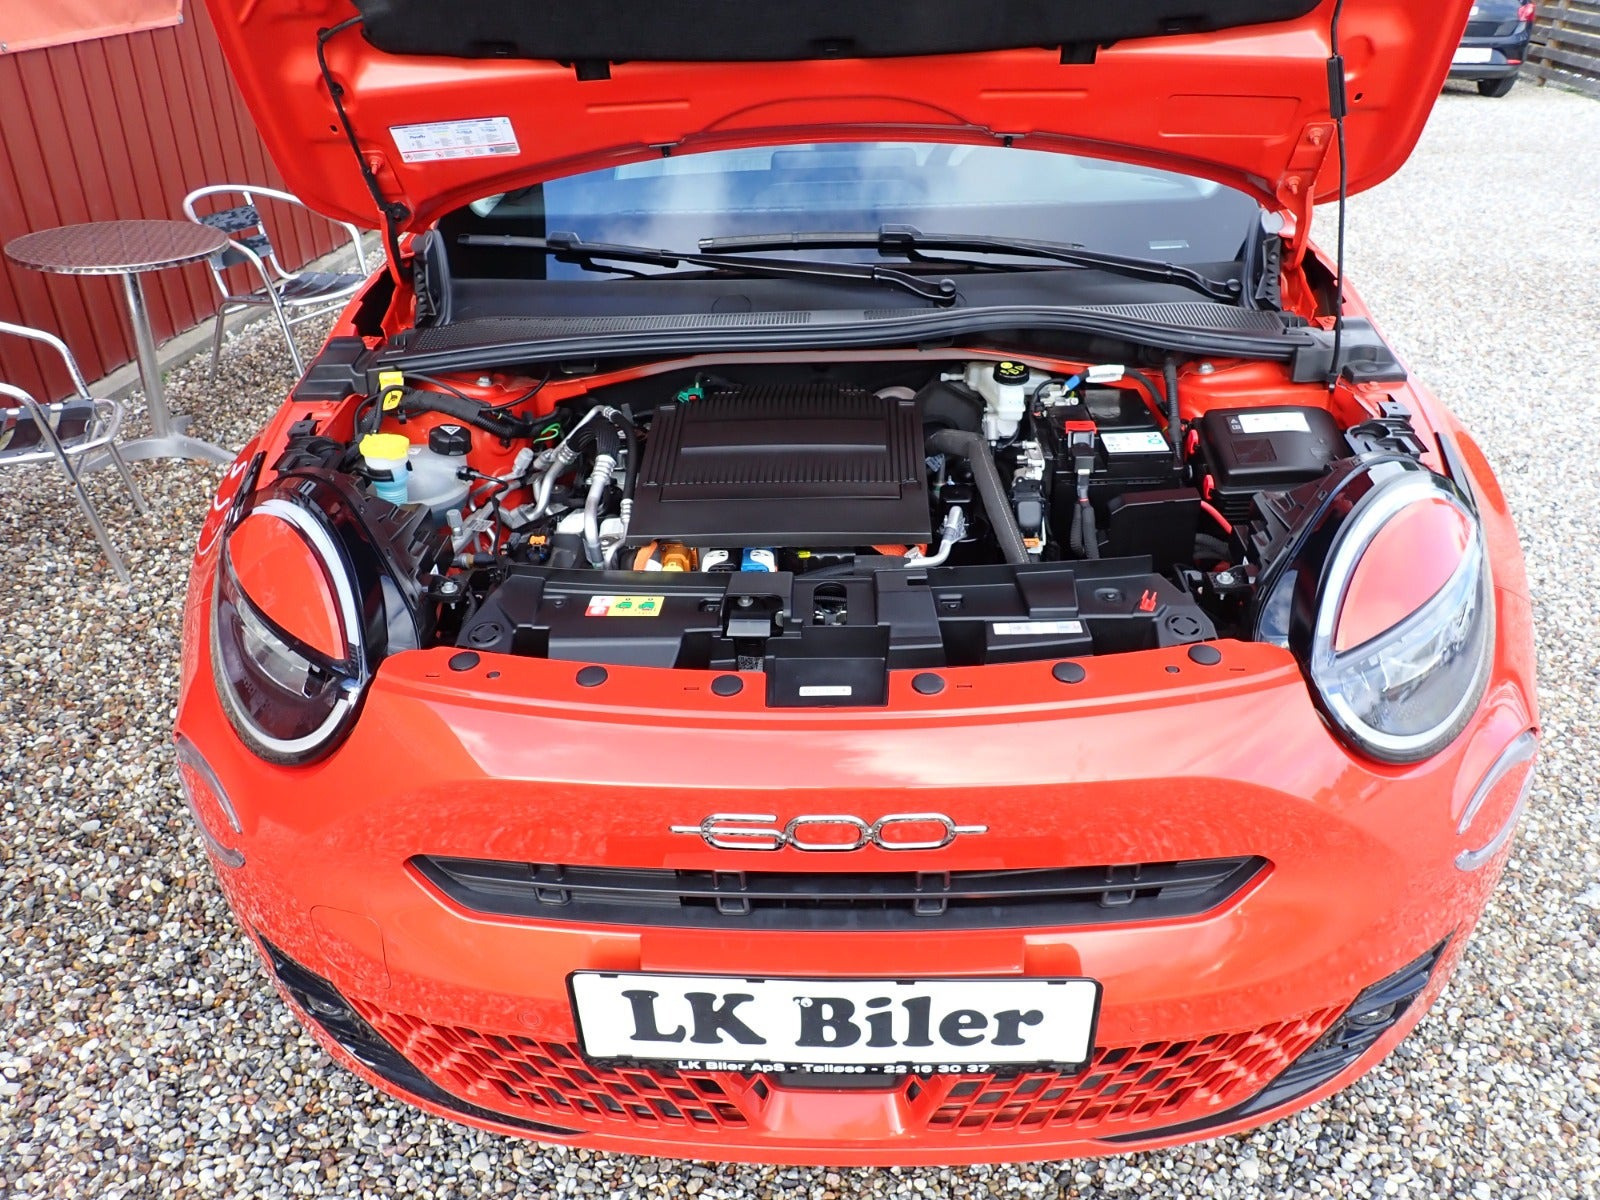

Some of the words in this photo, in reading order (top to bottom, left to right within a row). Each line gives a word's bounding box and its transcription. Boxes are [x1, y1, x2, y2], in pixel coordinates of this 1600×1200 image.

[700, 812, 958, 852] 600
[621, 989, 767, 1046] LK
[793, 996, 1043, 1048] Biler
[678, 1060, 701, 1069] LK
[706, 1061, 746, 1071] Biler
[751, 1062, 785, 1073] ApS
[884, 1064, 907, 1073] 22
[938, 1064, 962, 1073] 30
[967, 1064, 990, 1073] 37
